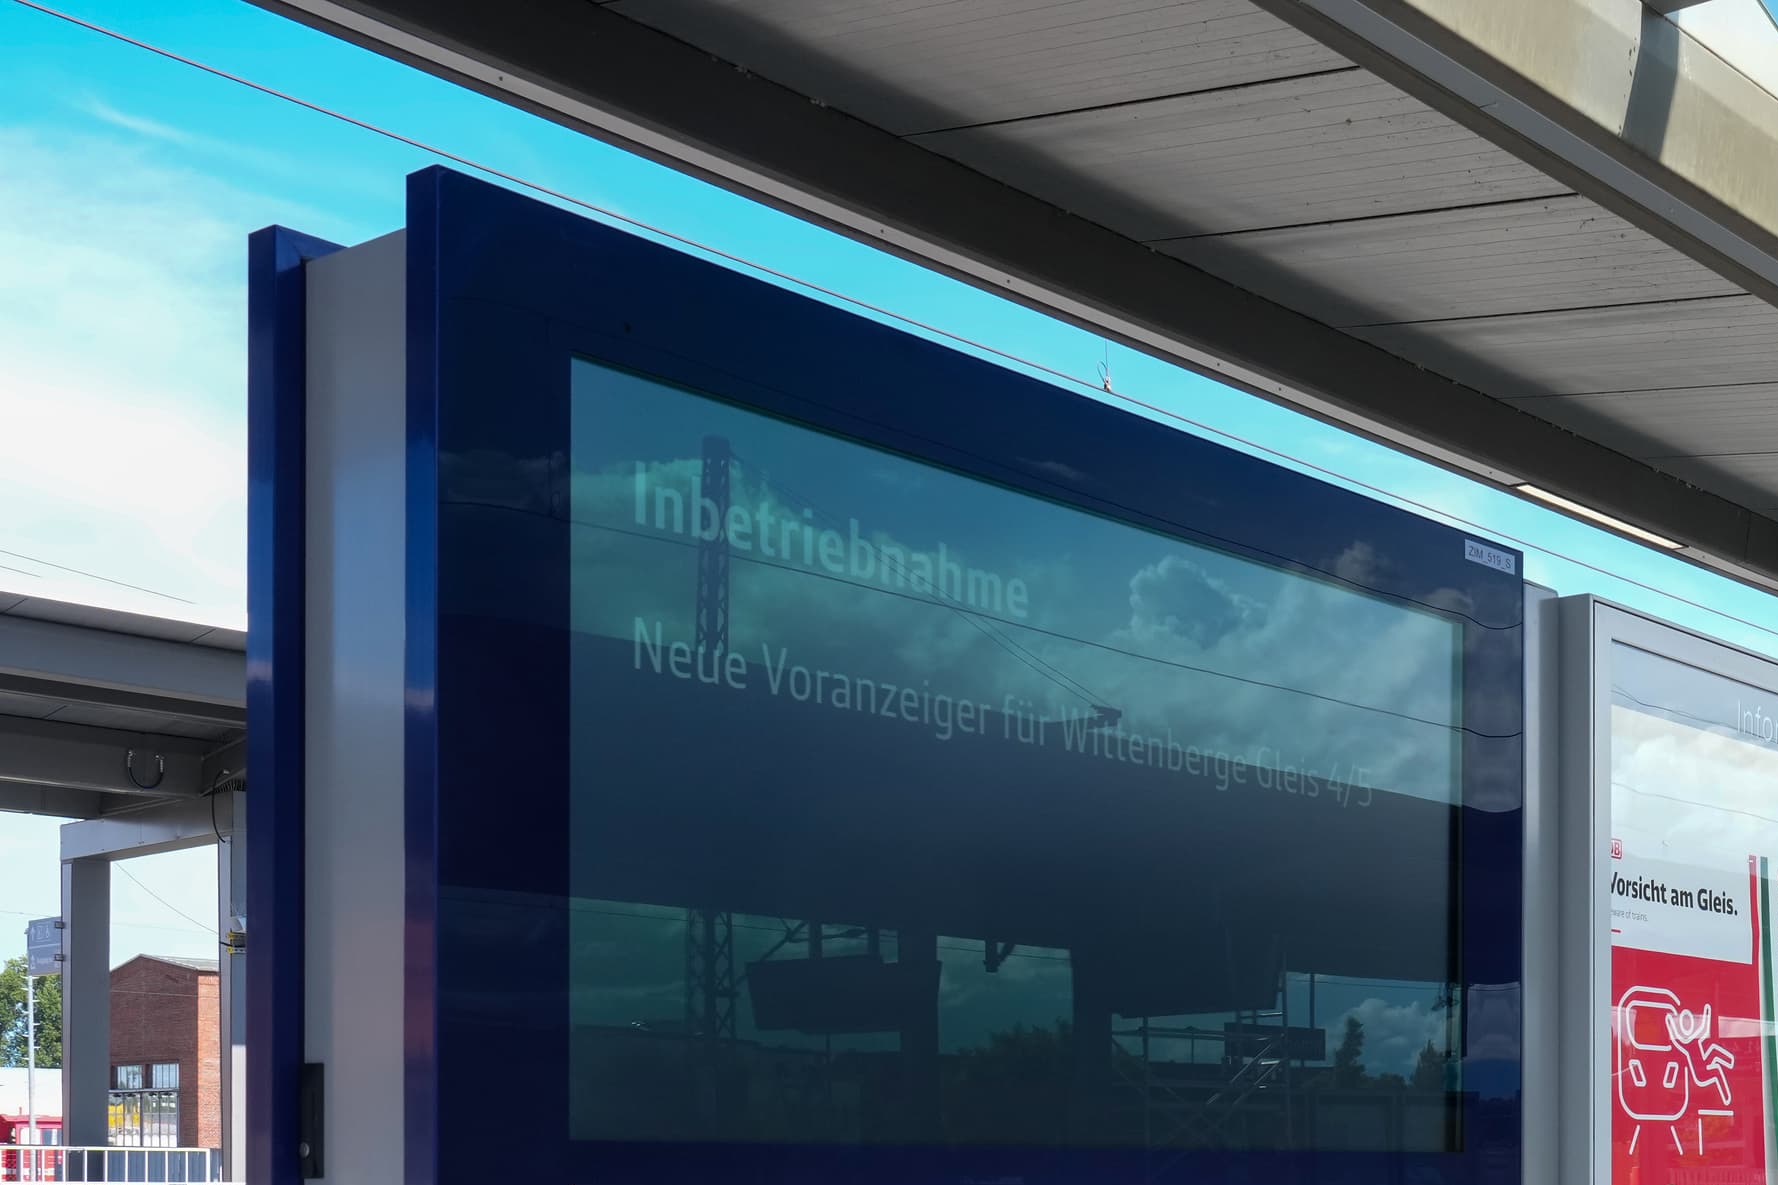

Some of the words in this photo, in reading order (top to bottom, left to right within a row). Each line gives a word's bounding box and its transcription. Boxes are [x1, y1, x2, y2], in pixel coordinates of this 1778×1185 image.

[634, 460, 1029, 618] Inbetriebnahme
[634, 616, 748, 689] Neue
[762, 643, 991, 740] Voranzeiger
[1002, 694, 1048, 746] für
[1061, 704, 1246, 791] Wittenberge
[1256, 746, 1319, 798] Gleis
[1327, 762, 1372, 808] 4/5
[1671, 888, 1694, 909] am
[1697, 888, 1738, 916] Gleis.
